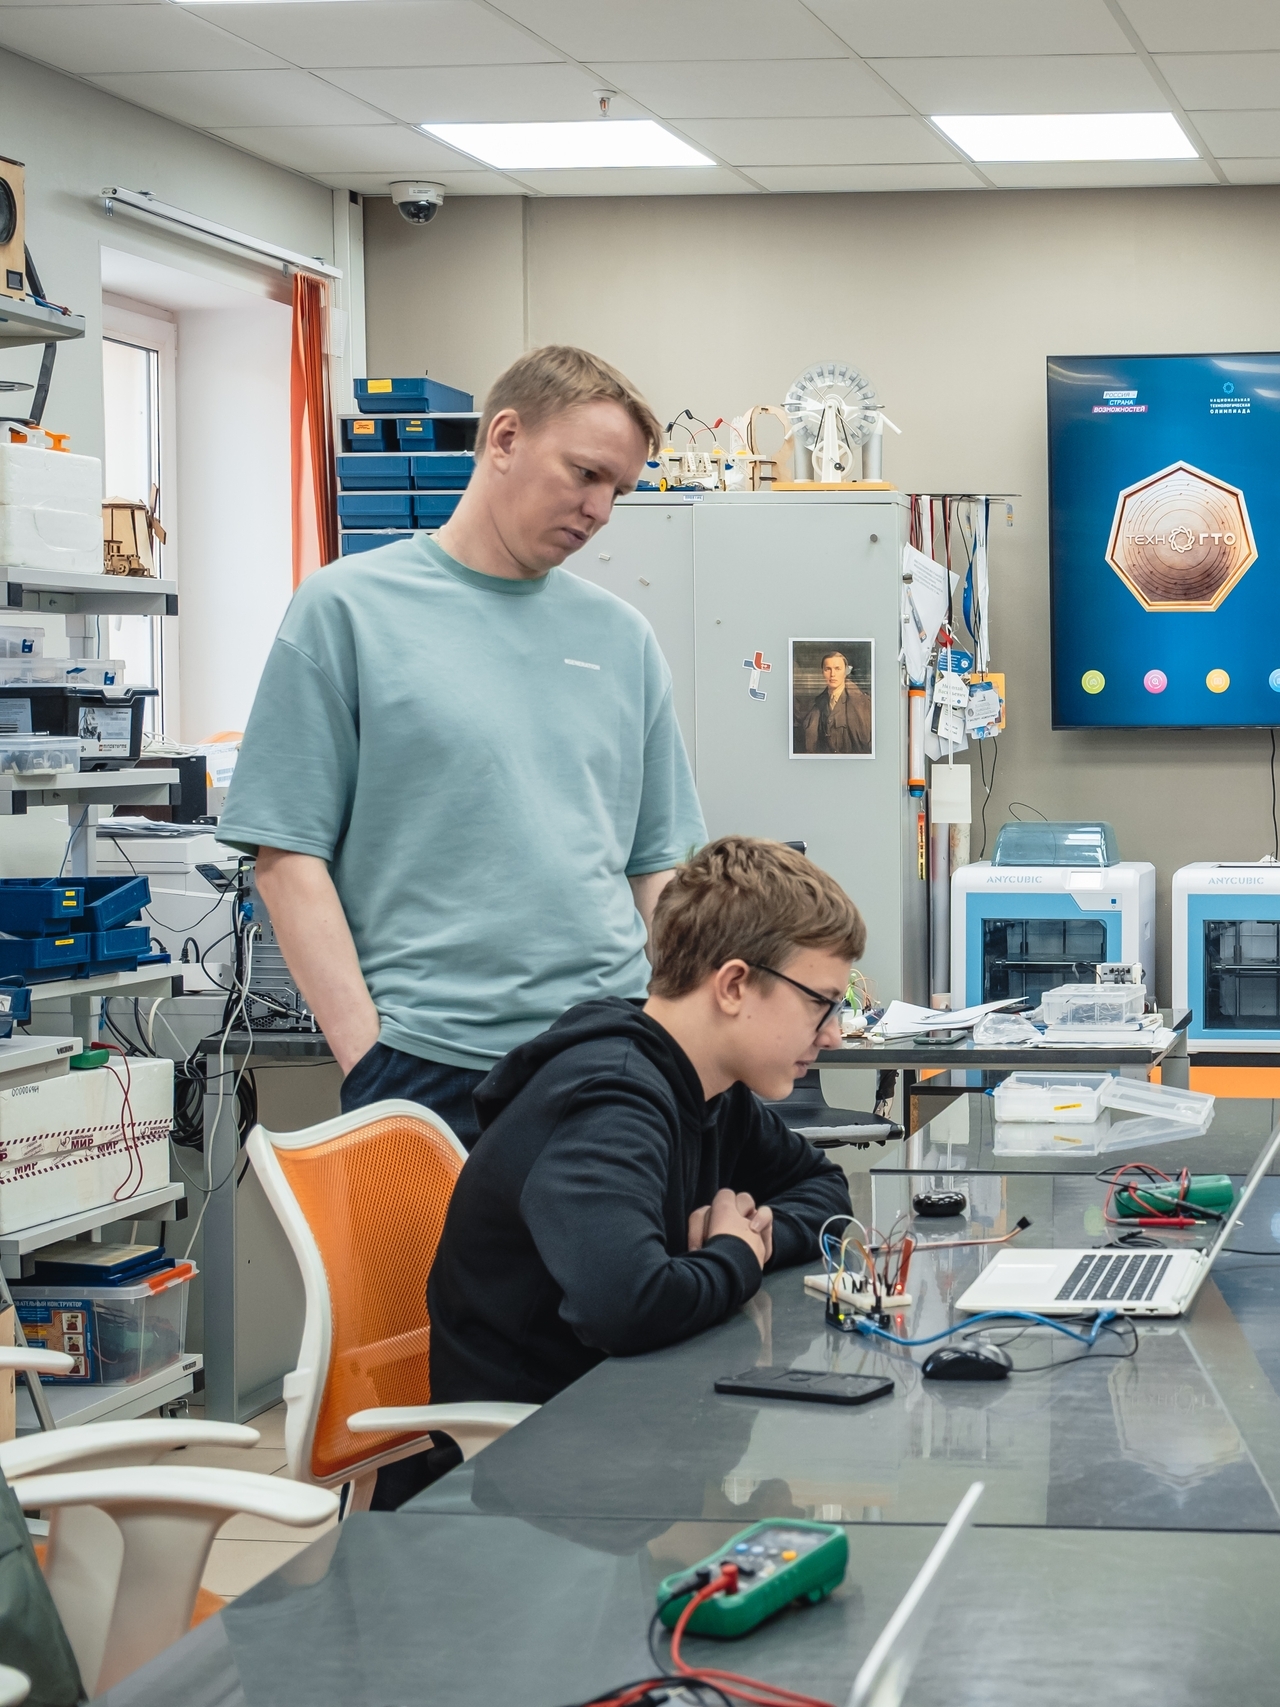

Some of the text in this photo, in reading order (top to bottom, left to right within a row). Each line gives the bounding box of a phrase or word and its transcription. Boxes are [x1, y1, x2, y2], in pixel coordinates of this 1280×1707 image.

[1208, 877, 1264, 885] ANYCUBIC
[71, 1138, 94, 1150] МИР
[97, 1141, 119, 1153] МИР
[14, 1161, 38, 1175] МИР
